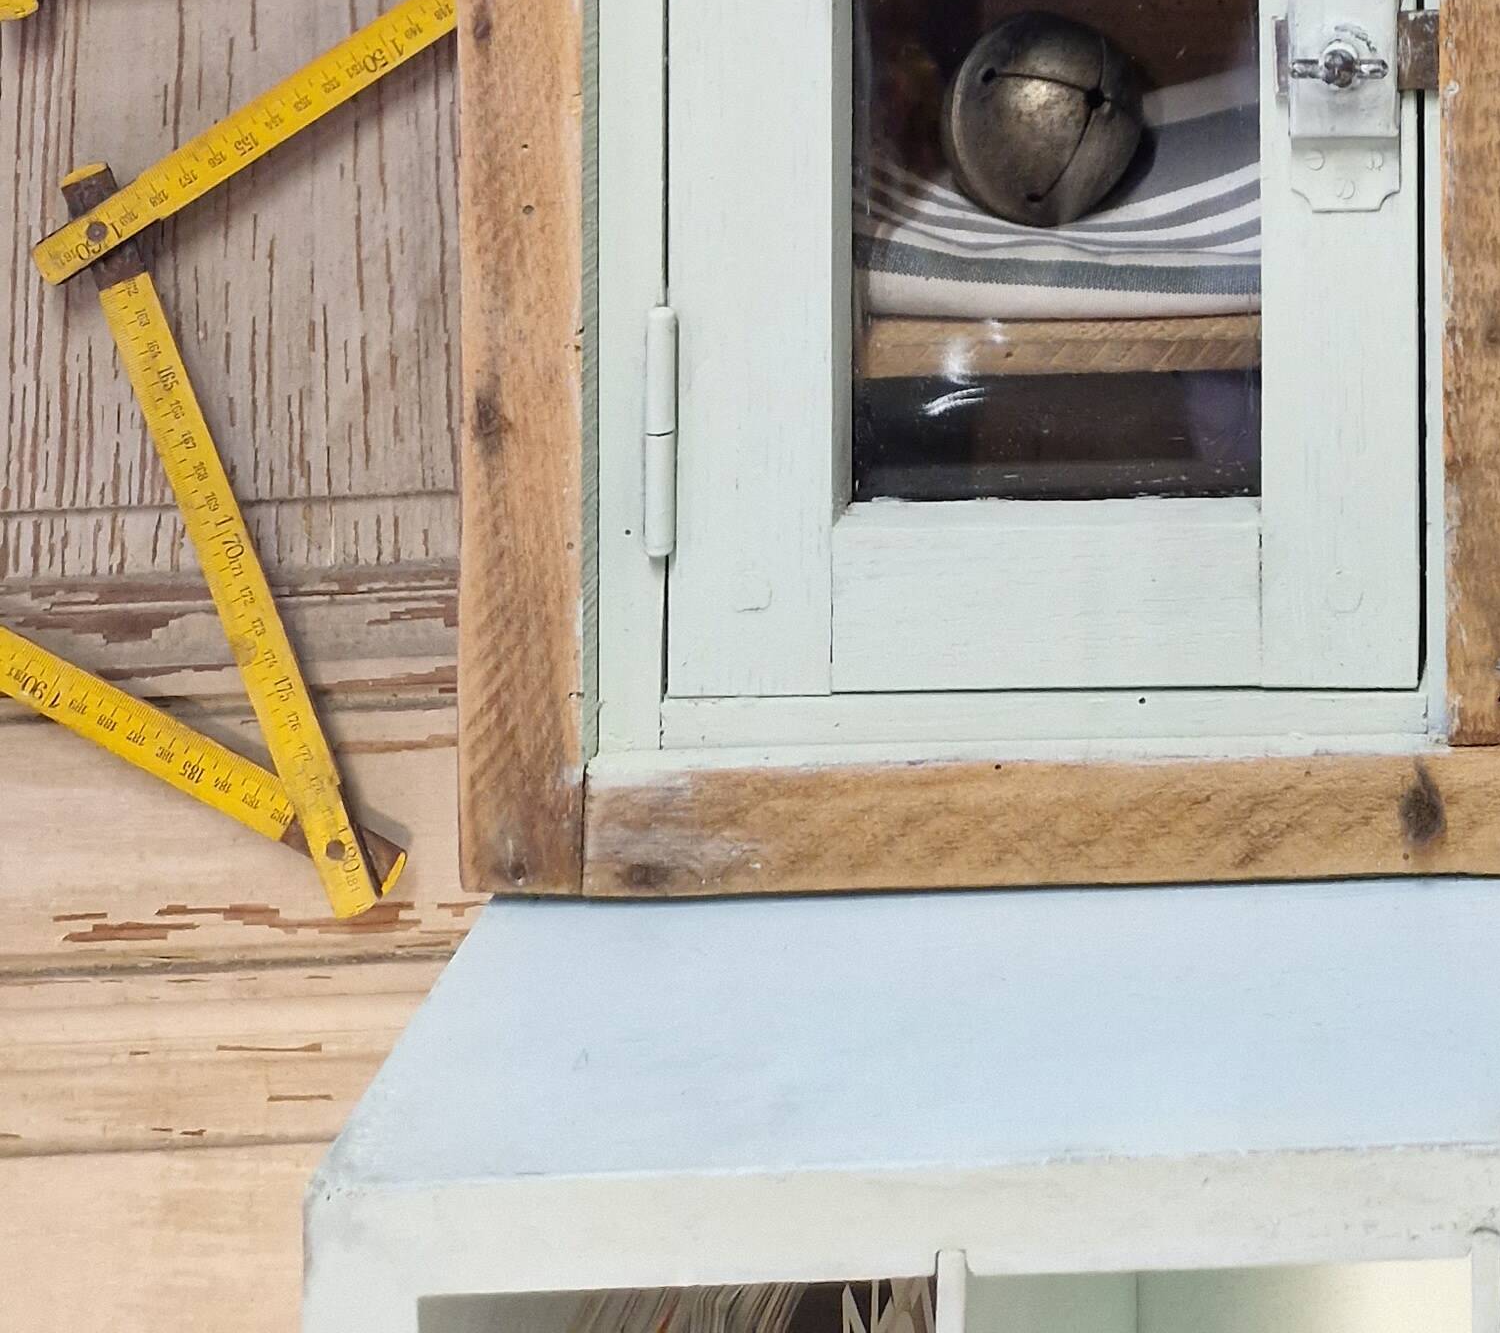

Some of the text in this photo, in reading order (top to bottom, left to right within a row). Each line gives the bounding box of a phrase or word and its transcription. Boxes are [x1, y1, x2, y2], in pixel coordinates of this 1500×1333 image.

[233, 132, 259, 157] 155
[158, 365, 180, 392] 165
[181, 430, 197, 450] 167
[274, 675, 295, 702] 175
[178, 760, 205, 784] 185
